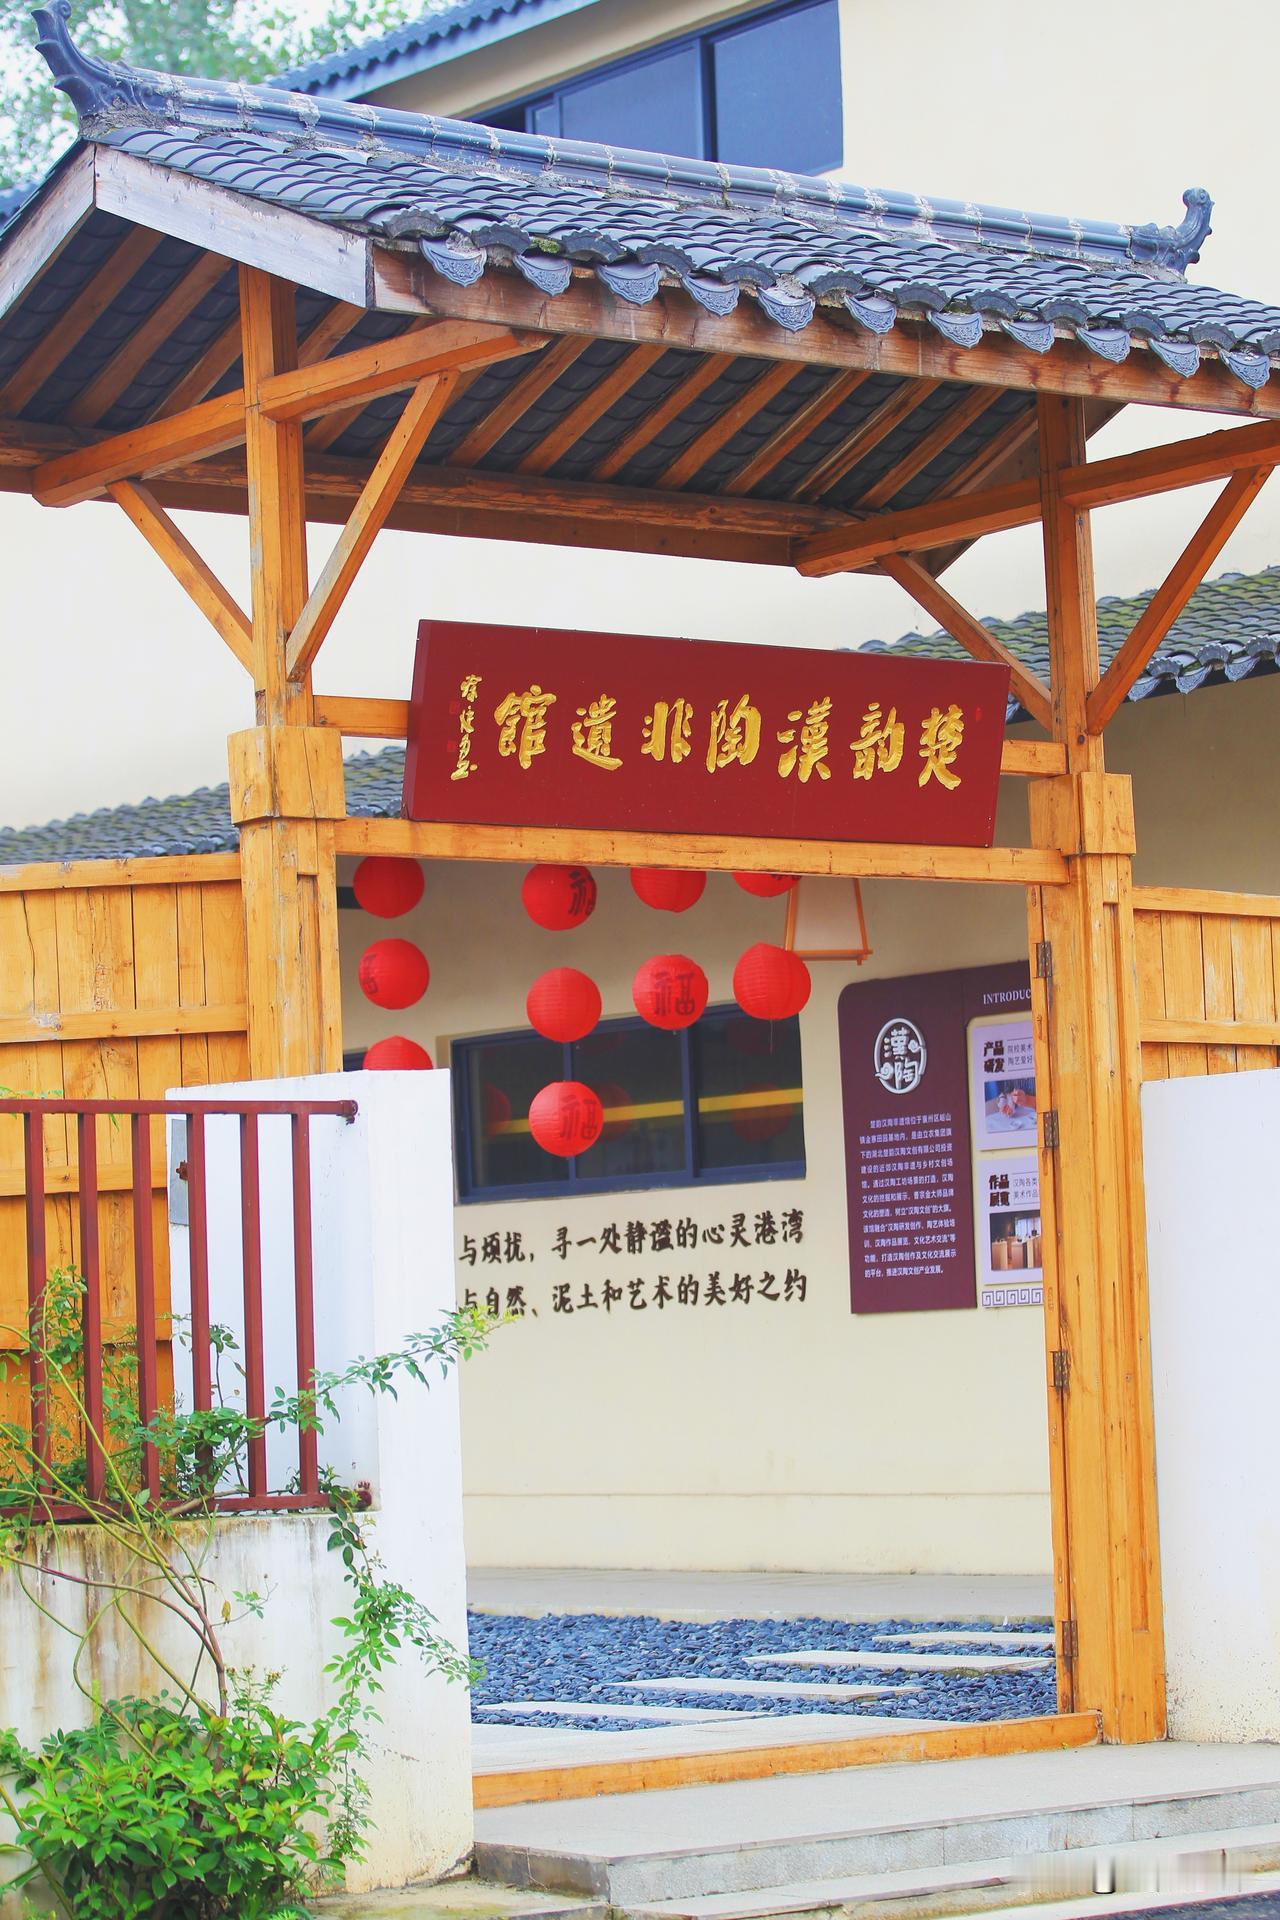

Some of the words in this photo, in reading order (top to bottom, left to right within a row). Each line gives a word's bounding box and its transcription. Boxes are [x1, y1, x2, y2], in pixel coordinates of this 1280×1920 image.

[652, 970, 697, 1017] 福
[983, 1040, 1005, 1057] 产品
[983, 1058, 1005, 1074] 研发
[557, 1092, 599, 1141] 福
[988, 1174, 1010, 1190] 作品
[989, 1191, 1011, 1207] 展览
[458, 1208, 804, 1266] 与烦扰，寻一处静谧的心灵港湾
